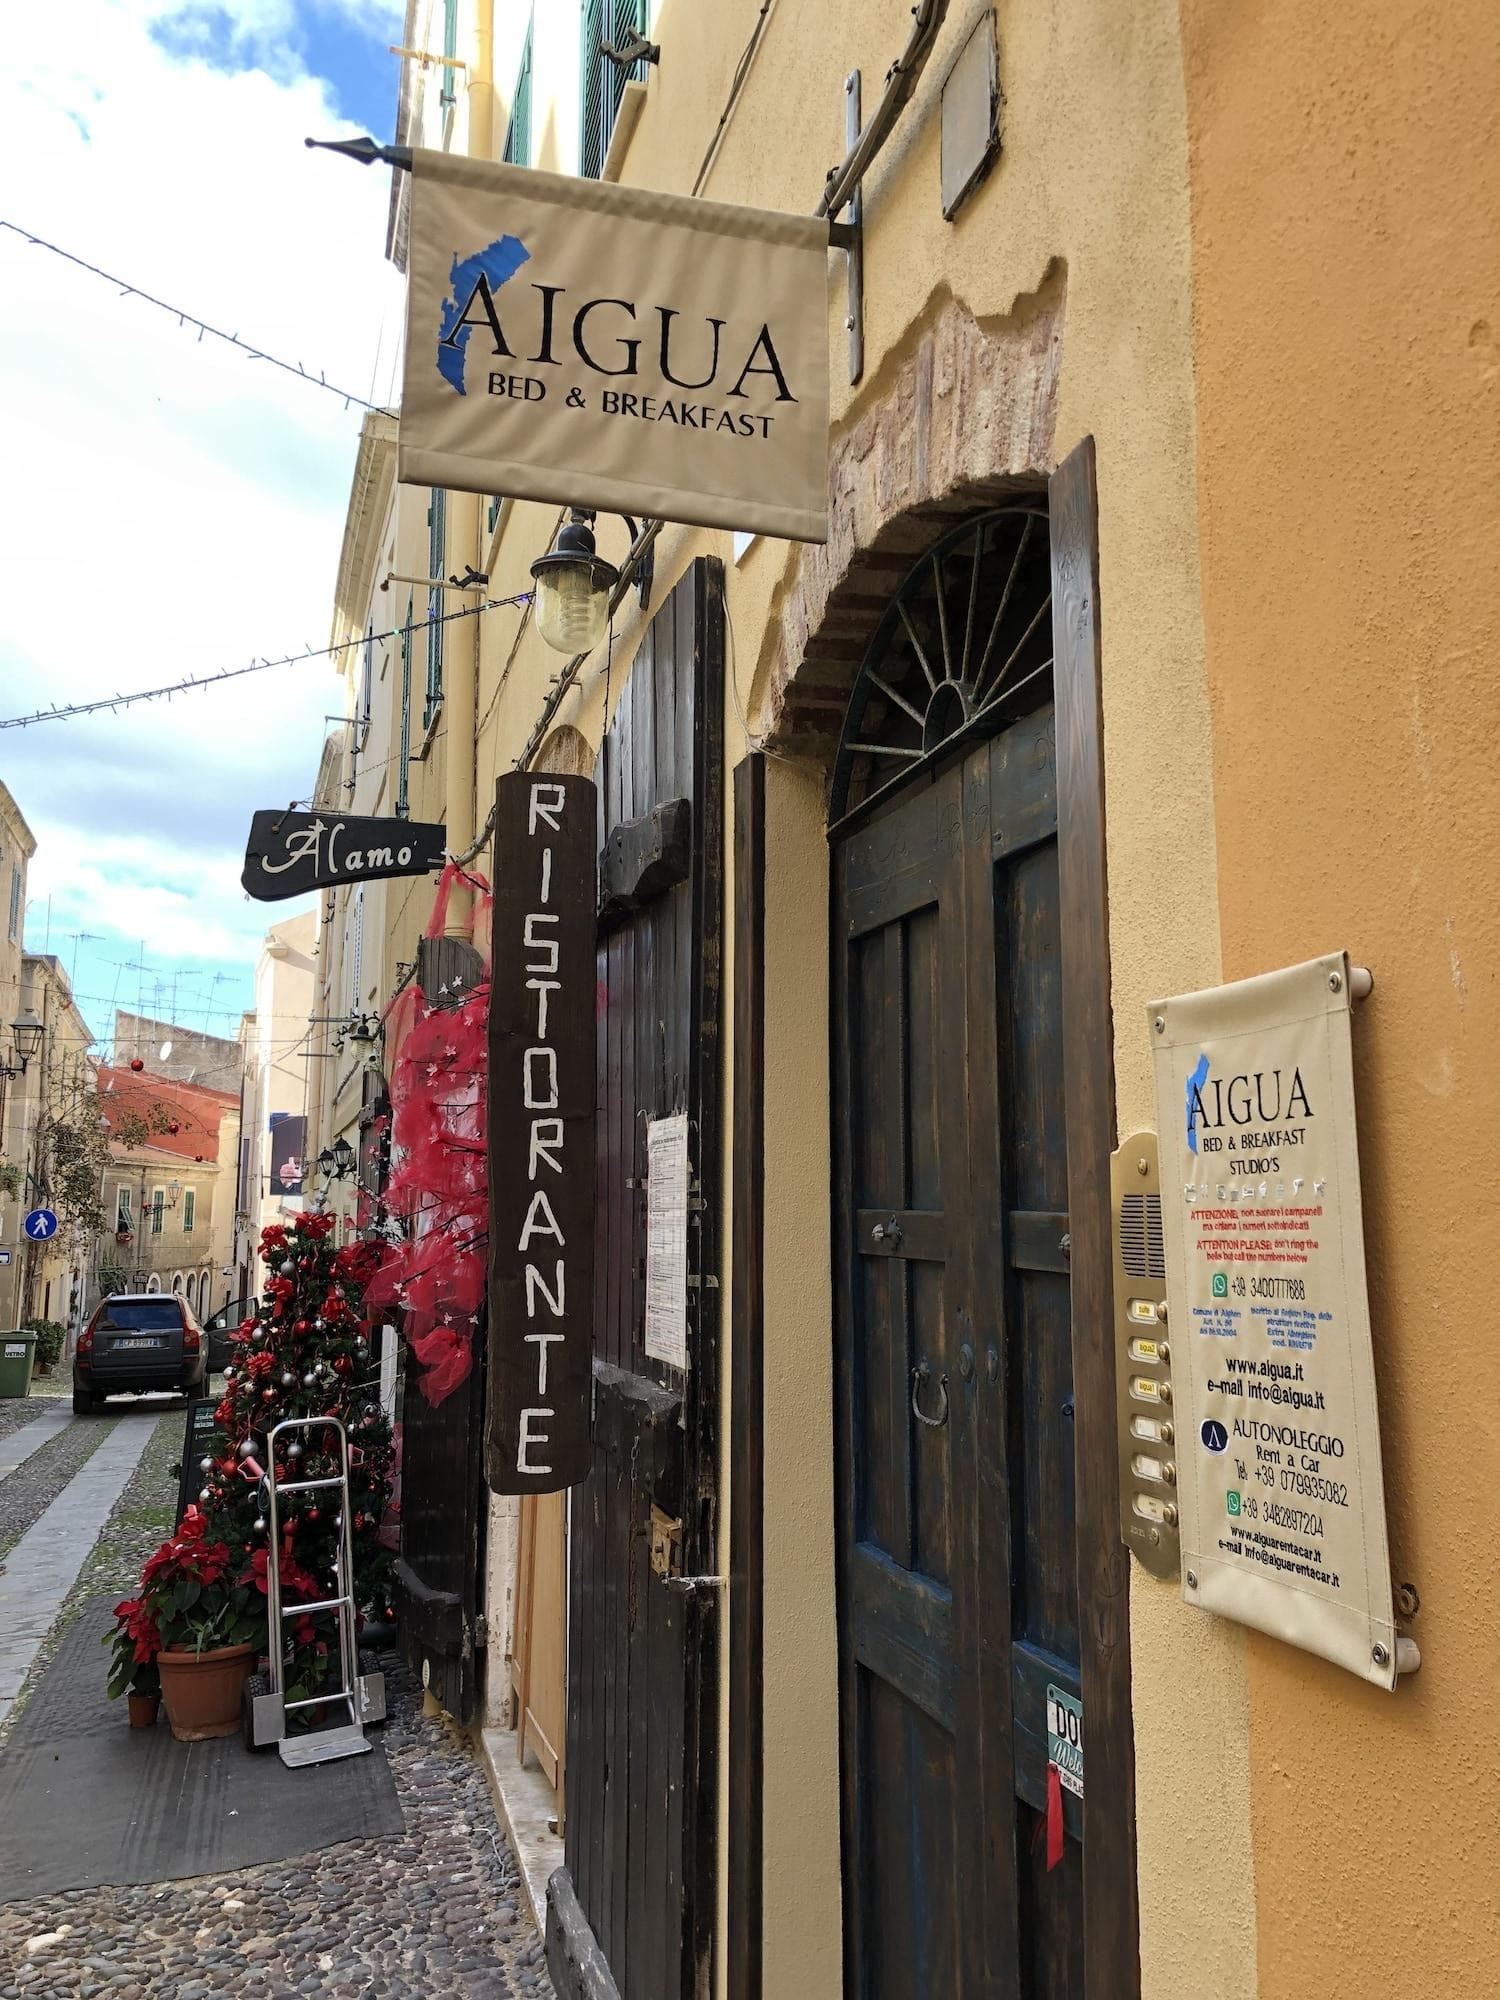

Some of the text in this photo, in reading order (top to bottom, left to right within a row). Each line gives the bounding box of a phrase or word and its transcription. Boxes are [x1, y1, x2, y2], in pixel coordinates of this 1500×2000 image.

[440, 272, 799, 403] AIGUA
[488, 372, 775, 439] BED & BREAKFAST
[1187, 1066, 1314, 1131] AIGUA
[517, 783, 566, 1474] RISTORANTE
[1203, 1128, 1306, 1153] BED & BREAKFAST
[1230, 1156, 1280, 1176] STUDIO'S
[1231, 1276, 1247, 1297] +39
[1226, 1358, 1304, 1382] www.aigua.it
[1207, 1379, 1326, 1410] e-mail info@aigua.it
[1233, 1418, 1345, 1458] AUTONOLEGGIO
[1256, 1445, 1320, 1473] Rent a Car
[1255, 1464, 1275, 1488] +39
[1280, 1469, 1349, 1507] 079935082
[1242, 1497, 1324, 1538] +39 3482897204
[1230, 1526, 1322, 1564] www.aiguarentacar.it
